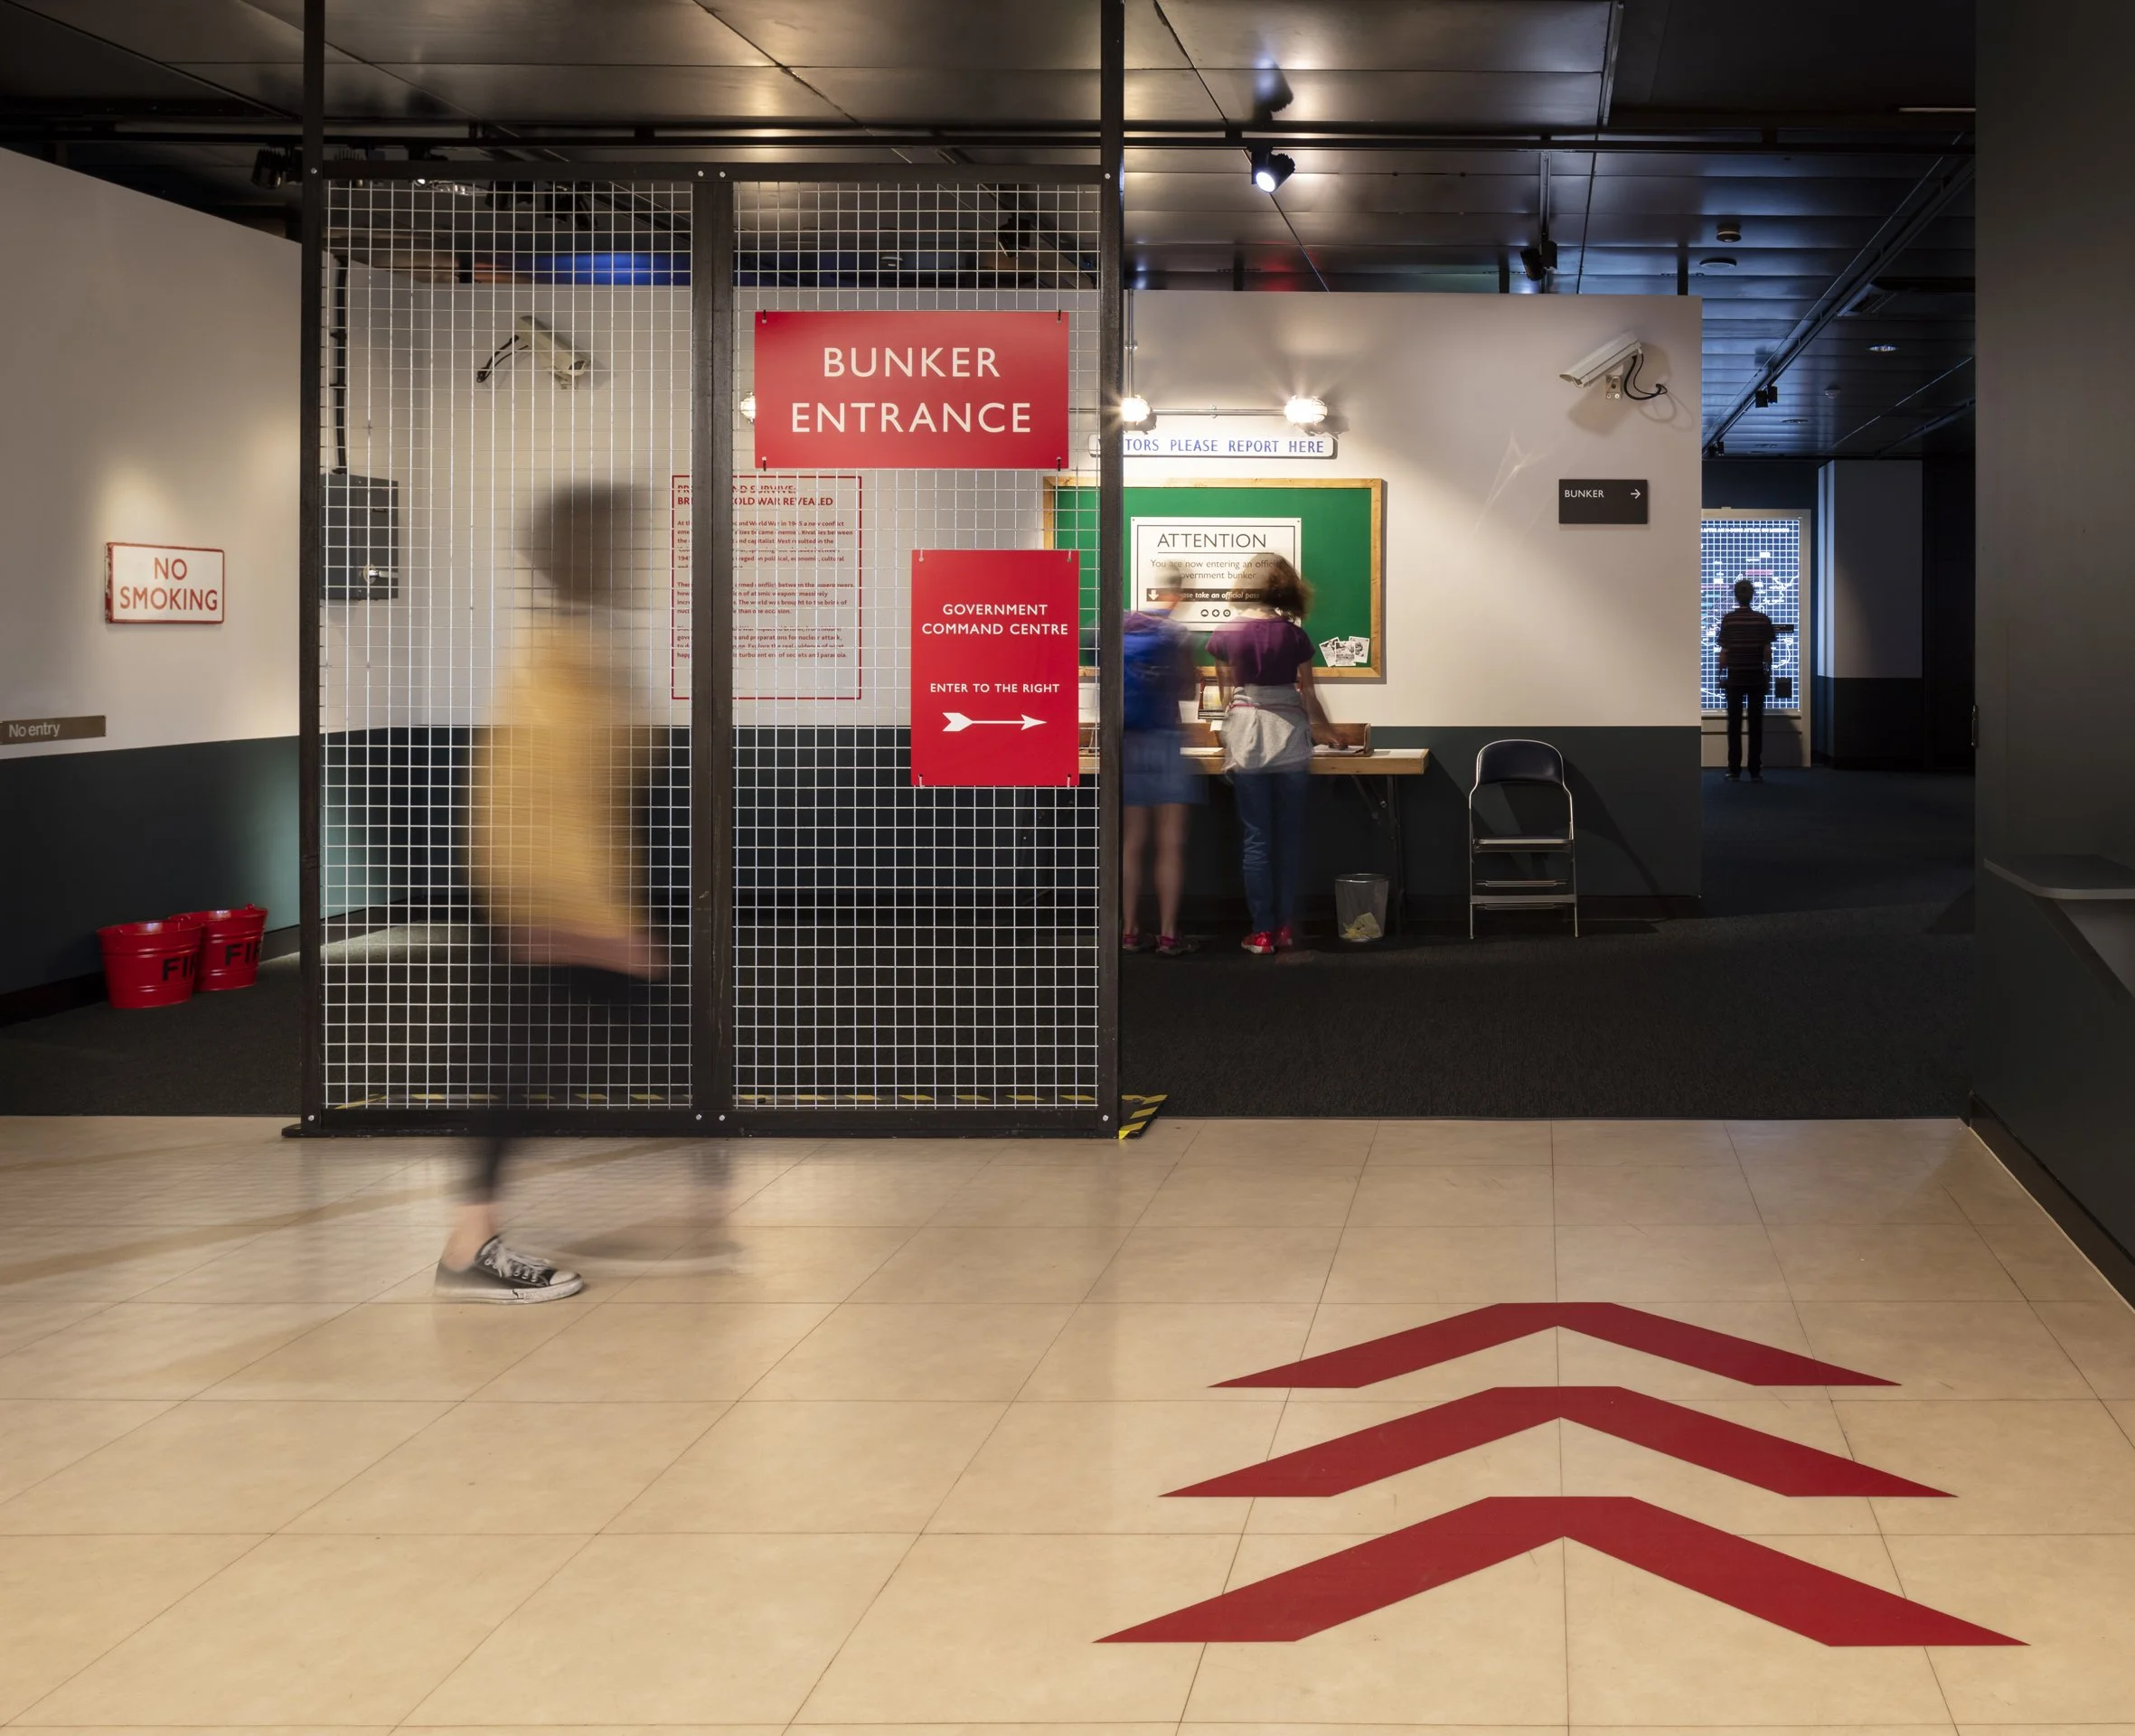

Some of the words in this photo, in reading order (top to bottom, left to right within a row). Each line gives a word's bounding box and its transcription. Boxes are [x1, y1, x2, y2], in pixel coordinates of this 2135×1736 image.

[823, 347, 1001, 378] BUNKER
[792, 402, 1031, 434] ENTRANCE
[1124, 438, 1160, 452] TORS
[1170, 439, 1218, 452] PLEASE
[1228, 439, 1280, 453] REPORT
[1288, 440, 1324, 453] HERE
[1564, 489, 1604, 498] BUNKER
[734, 497, 755, 506] OLD
[757, 497, 781, 506] WAR
[1157, 533, 1266, 548] ATTENTION
[154, 557, 188, 580] NO
[1151, 558, 1167, 568] You
[1206, 559, 1240, 569] entering
[1255, 558, 1275, 568] offici
[1180, 571, 1225, 579] overnment
[1227, 571, 1256, 579] bunker
[119, 586, 218, 611] SMOKING
[943, 604, 1048, 615] GOVERNMENT
[921, 623, 1003, 635] COMMAND
[1010, 624, 1068, 635] CENTRE
[930, 683, 968, 693] ENTER
[973, 683, 990, 693] TO
[994, 683, 1018, 693] THE
[1022, 683, 1060, 693] RIGHT
[9, 724, 27, 737] No
[28, 722, 61, 737] entry
